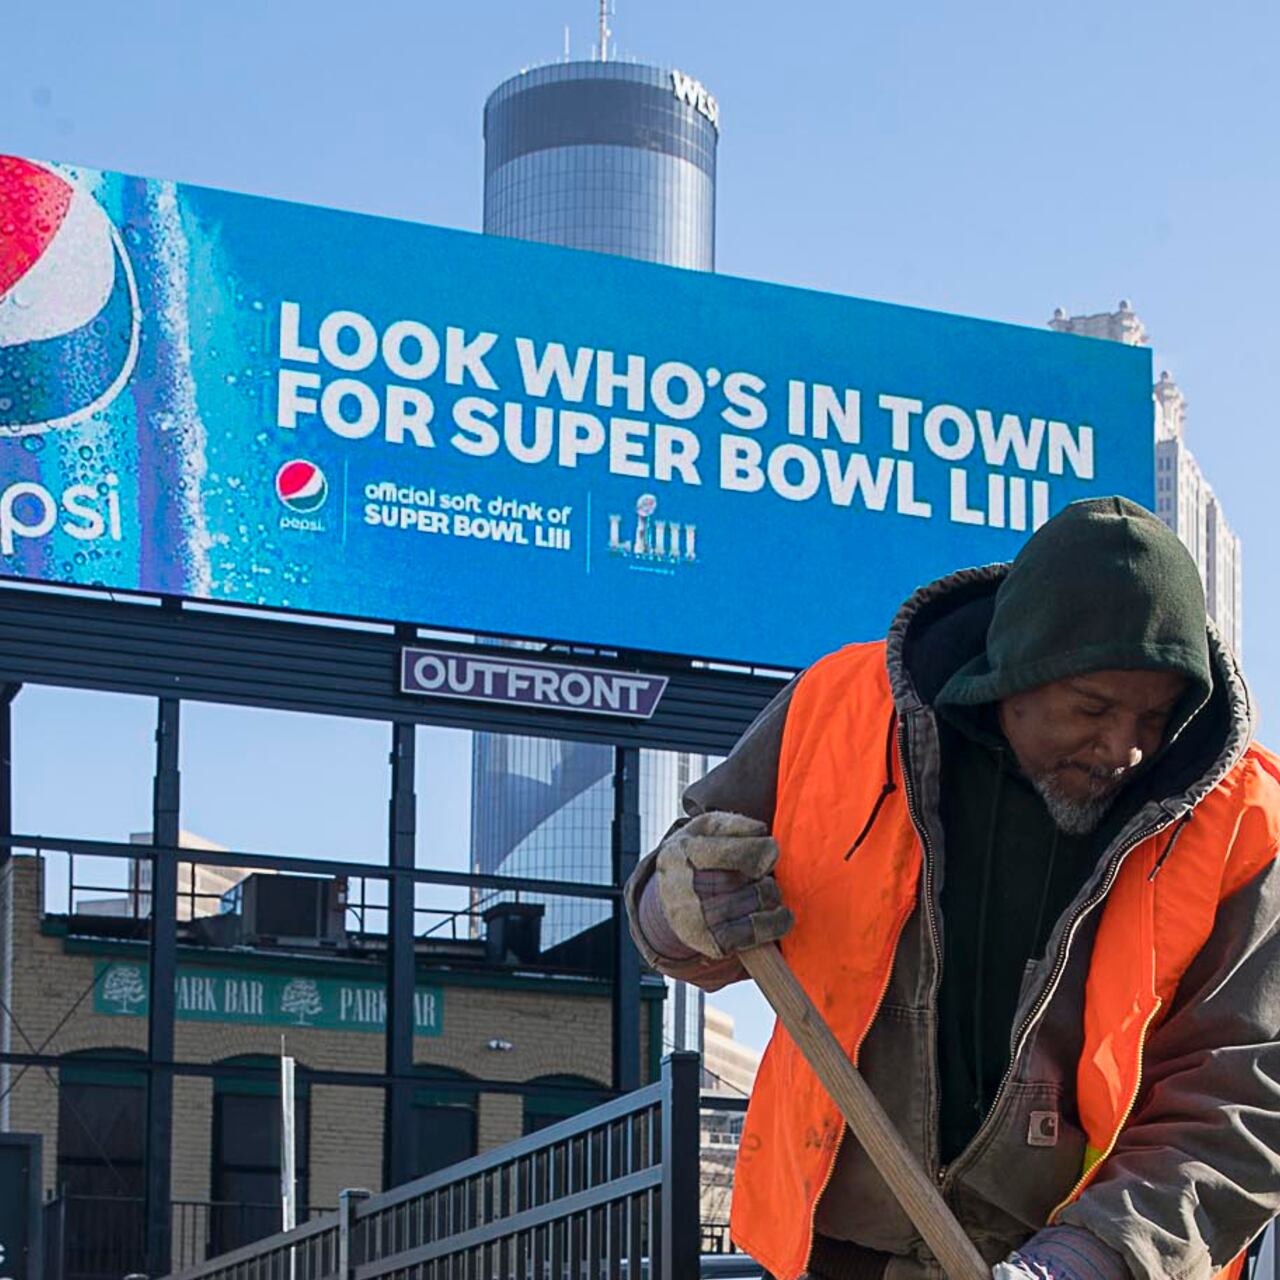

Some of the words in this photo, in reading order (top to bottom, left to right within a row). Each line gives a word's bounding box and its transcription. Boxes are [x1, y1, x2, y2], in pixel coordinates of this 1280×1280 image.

[279, 301, 499, 391] LOOK
[515, 335, 767, 431] WHO'S
[787, 379, 861, 445] IN
[879, 394, 1095, 479] TOWN
[277, 370, 434, 449] FOR
[451, 394, 702, 485] SUPER
[720, 435, 933, 519] BOWL
[951, 467, 1051, 533] LIII
[363, 481, 436, 507] official
[439, 488, 482, 513] soft
[487, 494, 543, 523] drink
[547, 504, 573, 525] of
[363, 503, 449, 534] SUPER
[453, 516, 528, 546] BOWL
[535, 526, 571, 551] LIII
[414, 655, 650, 712] OUTFRONT
[174, 976, 217, 1012] ARK
[224, 979, 264, 1015] BAR
[413, 992, 436, 1027] AR
